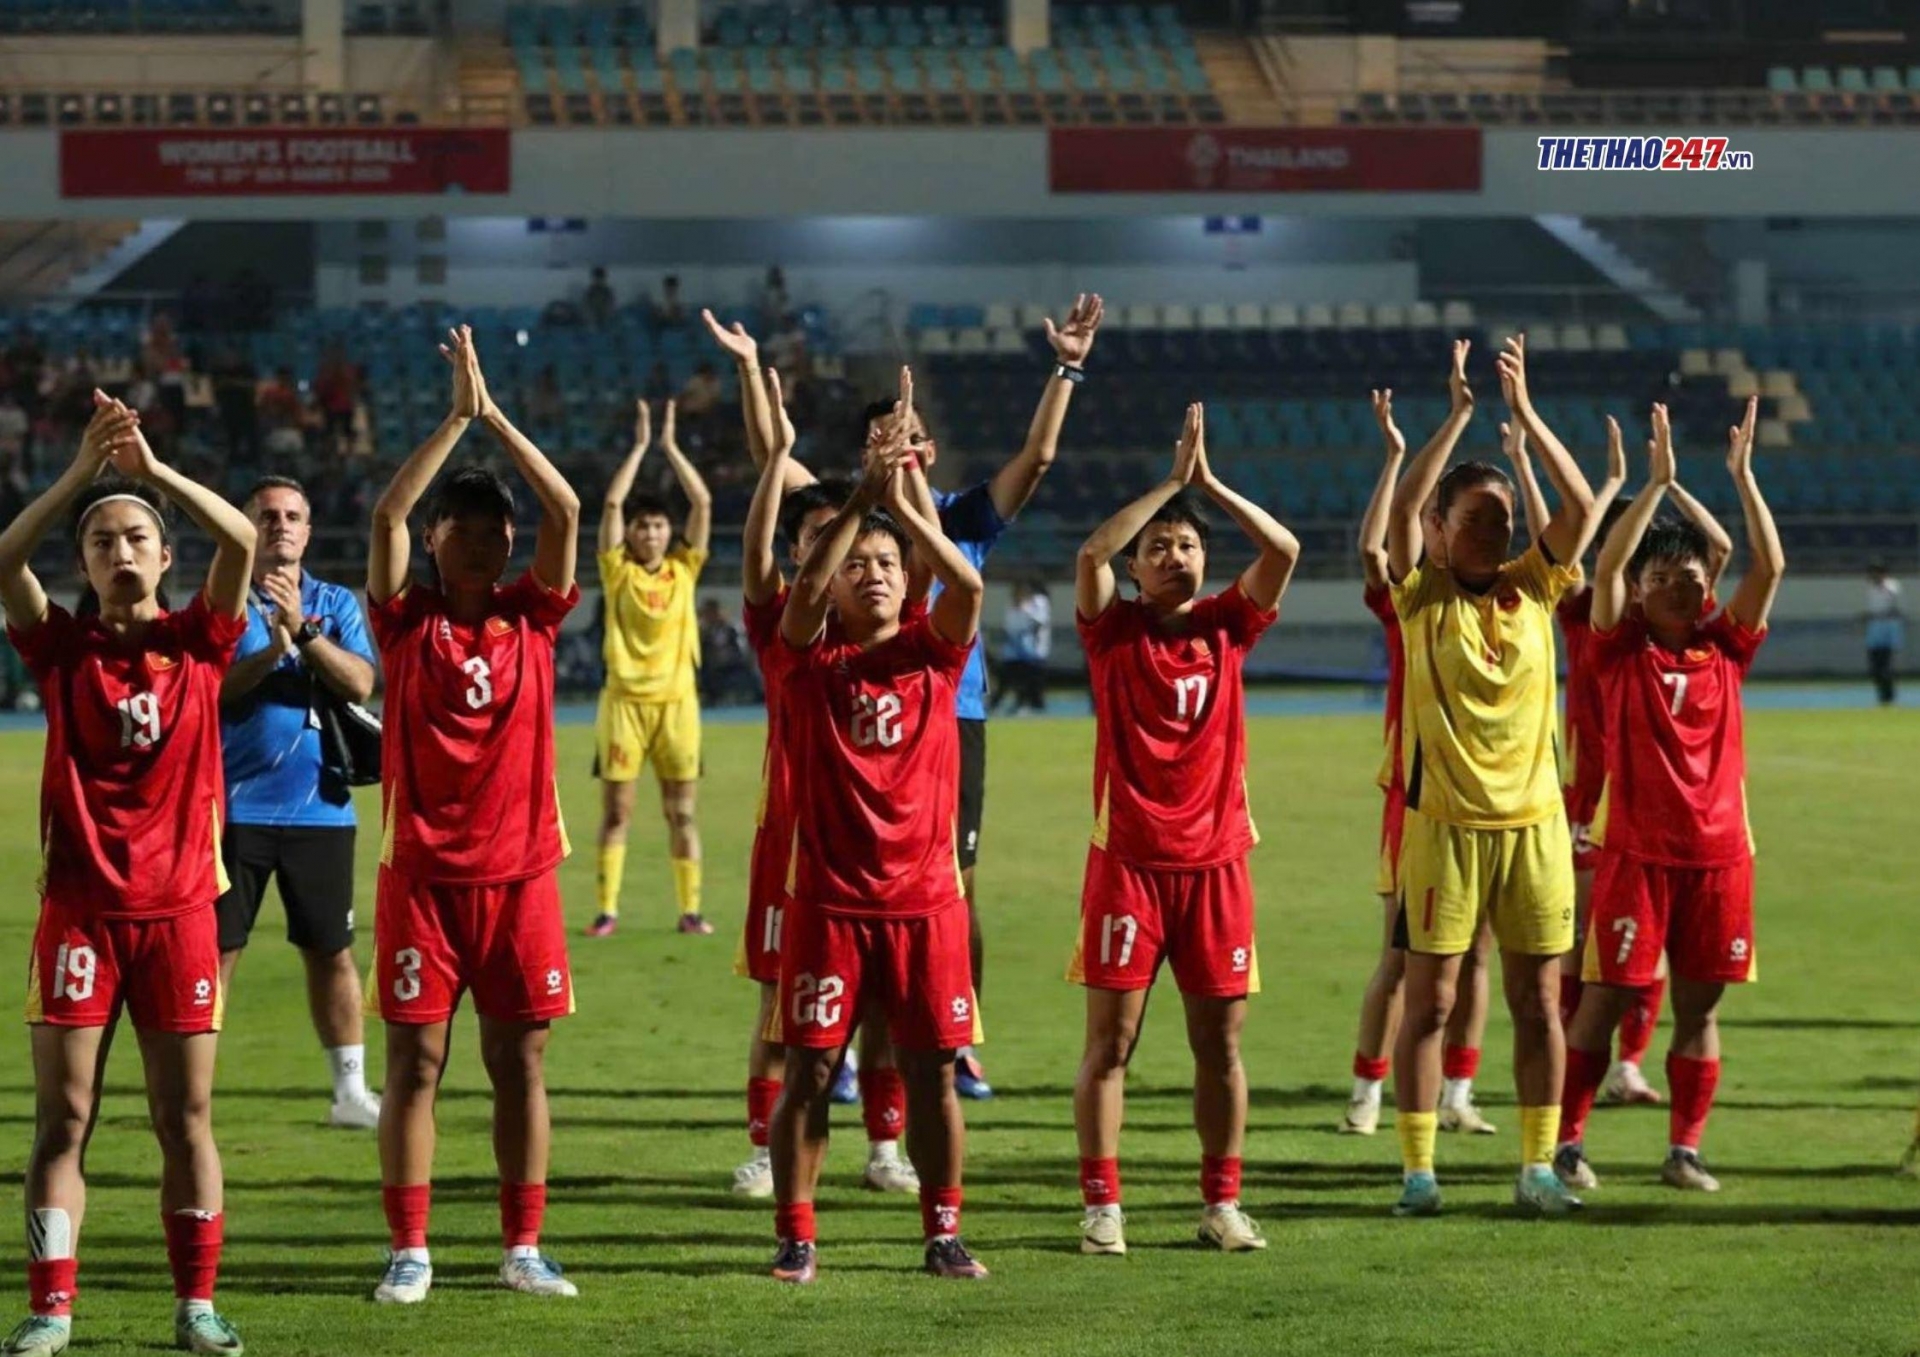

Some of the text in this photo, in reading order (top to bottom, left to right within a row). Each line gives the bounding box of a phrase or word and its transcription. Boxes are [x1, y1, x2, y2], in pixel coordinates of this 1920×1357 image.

[287, 138, 416, 163] FOOTBALL
[1228, 146, 1348, 167] THAILAND
[462, 656, 492, 710] 3
[1174, 674, 1208, 720] 17
[1663, 672, 1688, 715] 7
[117, 692, 160, 748] 19
[1099, 914, 1138, 967] 17
[1612, 916, 1639, 964] 7
[52, 943, 97, 1001] 19
[393, 947, 422, 1002] 3
